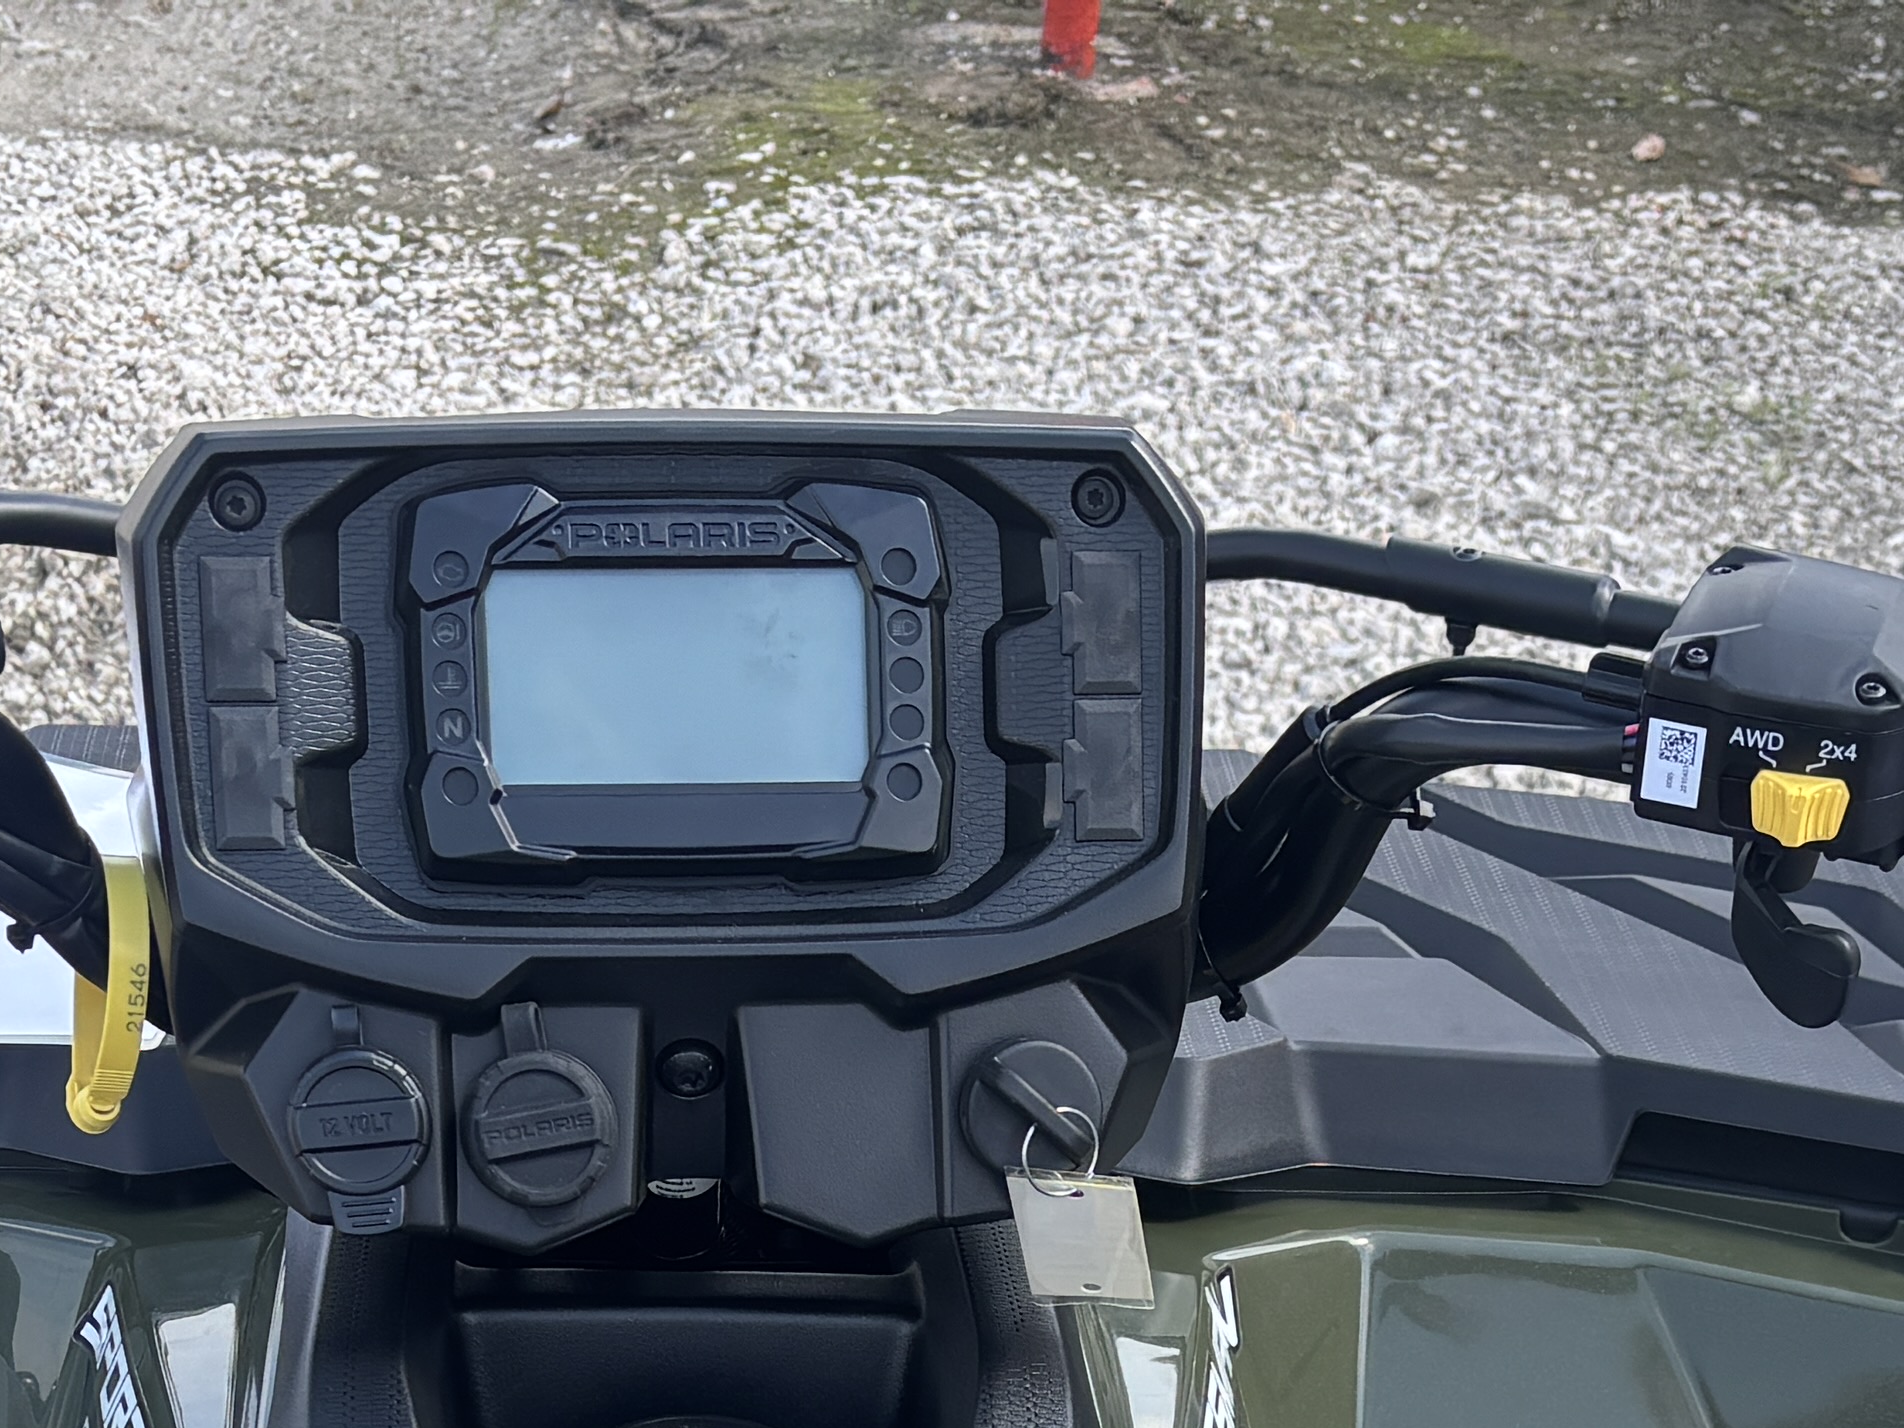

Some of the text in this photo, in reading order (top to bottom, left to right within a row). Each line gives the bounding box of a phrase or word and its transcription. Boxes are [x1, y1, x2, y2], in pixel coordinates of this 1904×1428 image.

[444, 717, 463, 737] N
[1729, 726, 1784, 751] AWD
[1819, 740, 1858, 761] 2x4
[127, 962, 147, 1033] 21546
[480, 1112, 595, 1144] POLARIS
